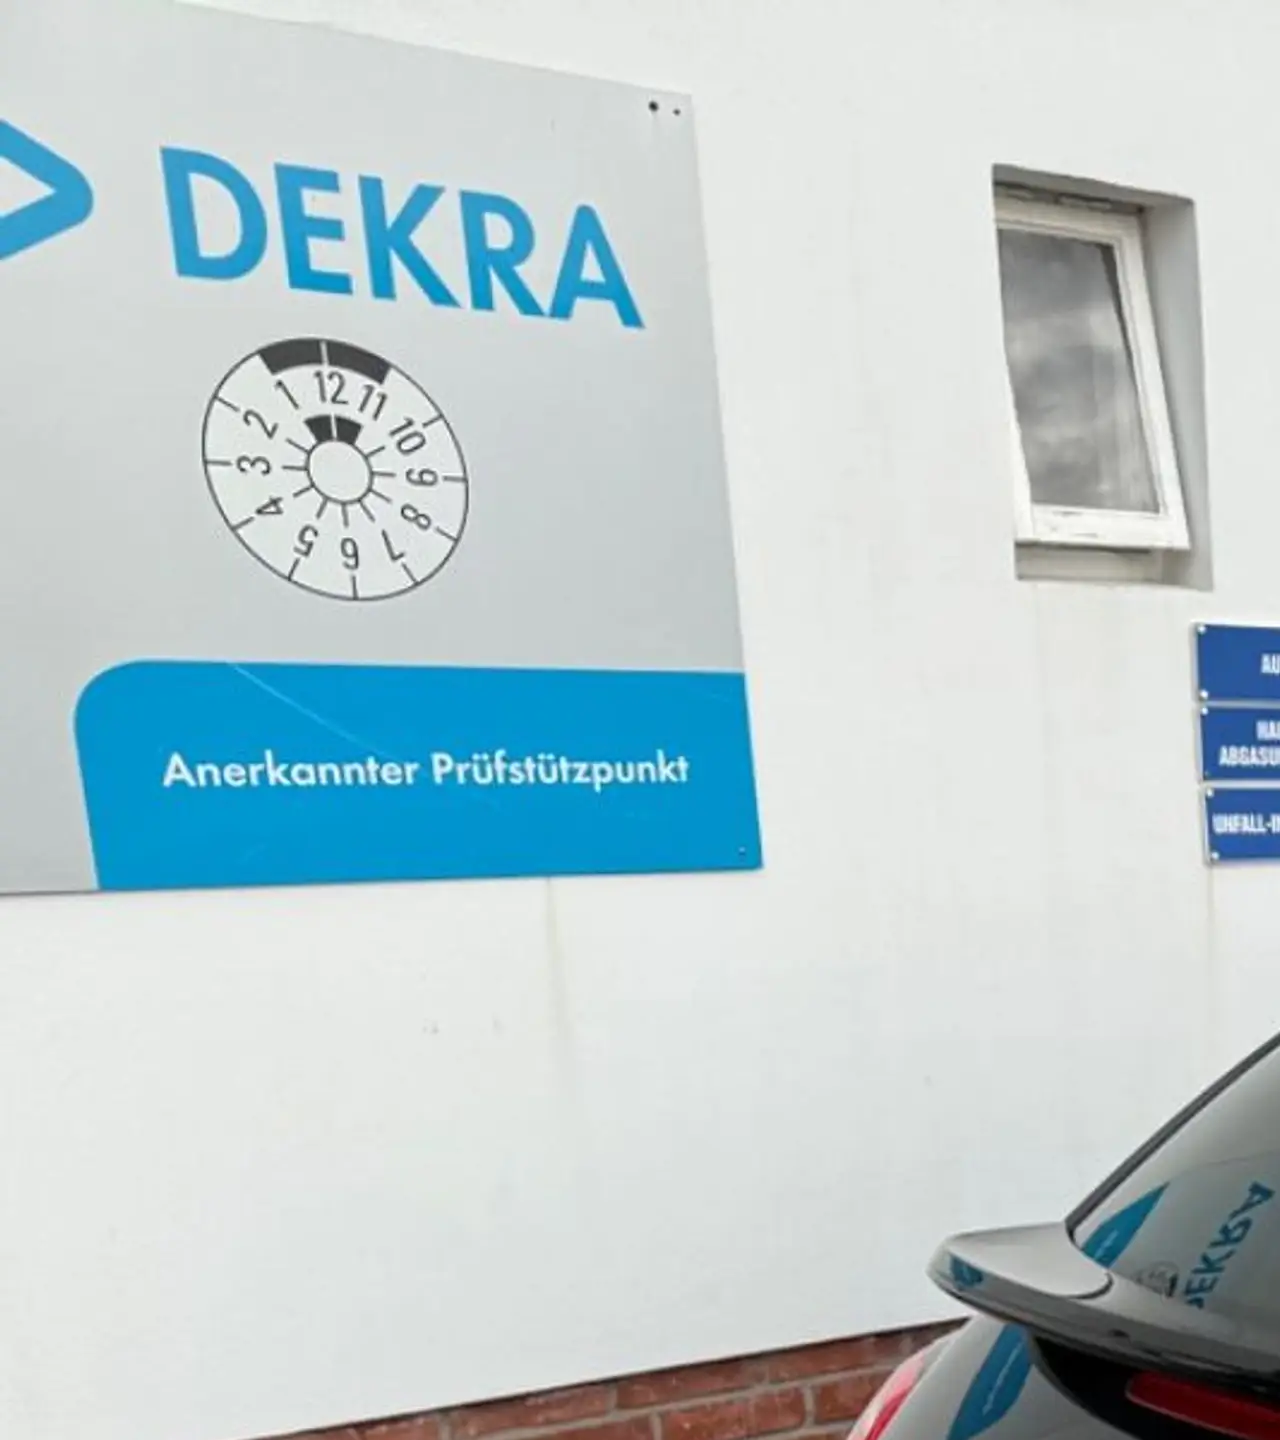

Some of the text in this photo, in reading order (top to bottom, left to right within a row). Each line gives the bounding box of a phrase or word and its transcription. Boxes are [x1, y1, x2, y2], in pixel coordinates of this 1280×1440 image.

[160, 146, 645, 329] DEKRA
[274, 379, 300, 410] 1
[314, 370, 350, 406] 12
[358, 384, 388, 421] 11
[243, 409, 279, 439] 2
[388, 417, 427, 456] 10
[236, 455, 271, 476] 3
[405, 467, 438, 487] 9
[256, 496, 284, 516] 4
[400, 503, 432, 531] 8
[293, 525, 319, 558] 5
[340, 537, 360, 570] 6
[381, 529, 405, 562] 7
[162, 749, 689, 793] Anerkannter Prüfstützpunkt
